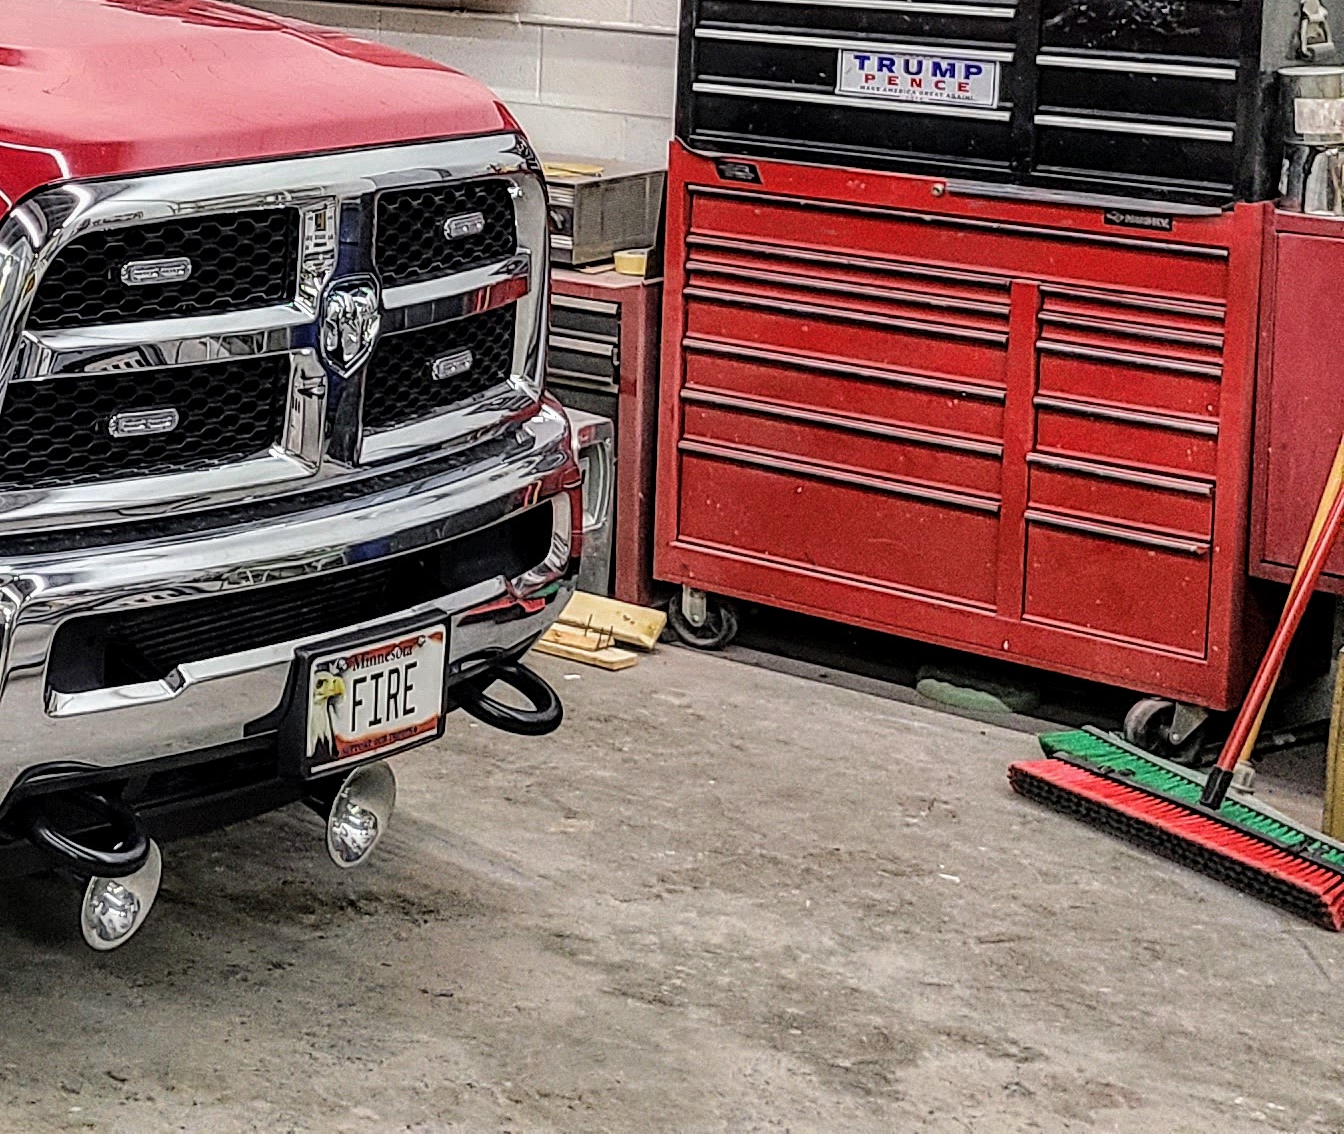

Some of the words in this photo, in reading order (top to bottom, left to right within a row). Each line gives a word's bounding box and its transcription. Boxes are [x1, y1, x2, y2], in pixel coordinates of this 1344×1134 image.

[853, 54, 983, 80] TRUMP
[864, 73, 970, 93] PENCE
[882, 87, 917, 96] AMERICA
[918, 90, 944, 98] GREAT
[352, 645, 414, 672] Minnesota
[351, 661, 418, 733] FIRE
